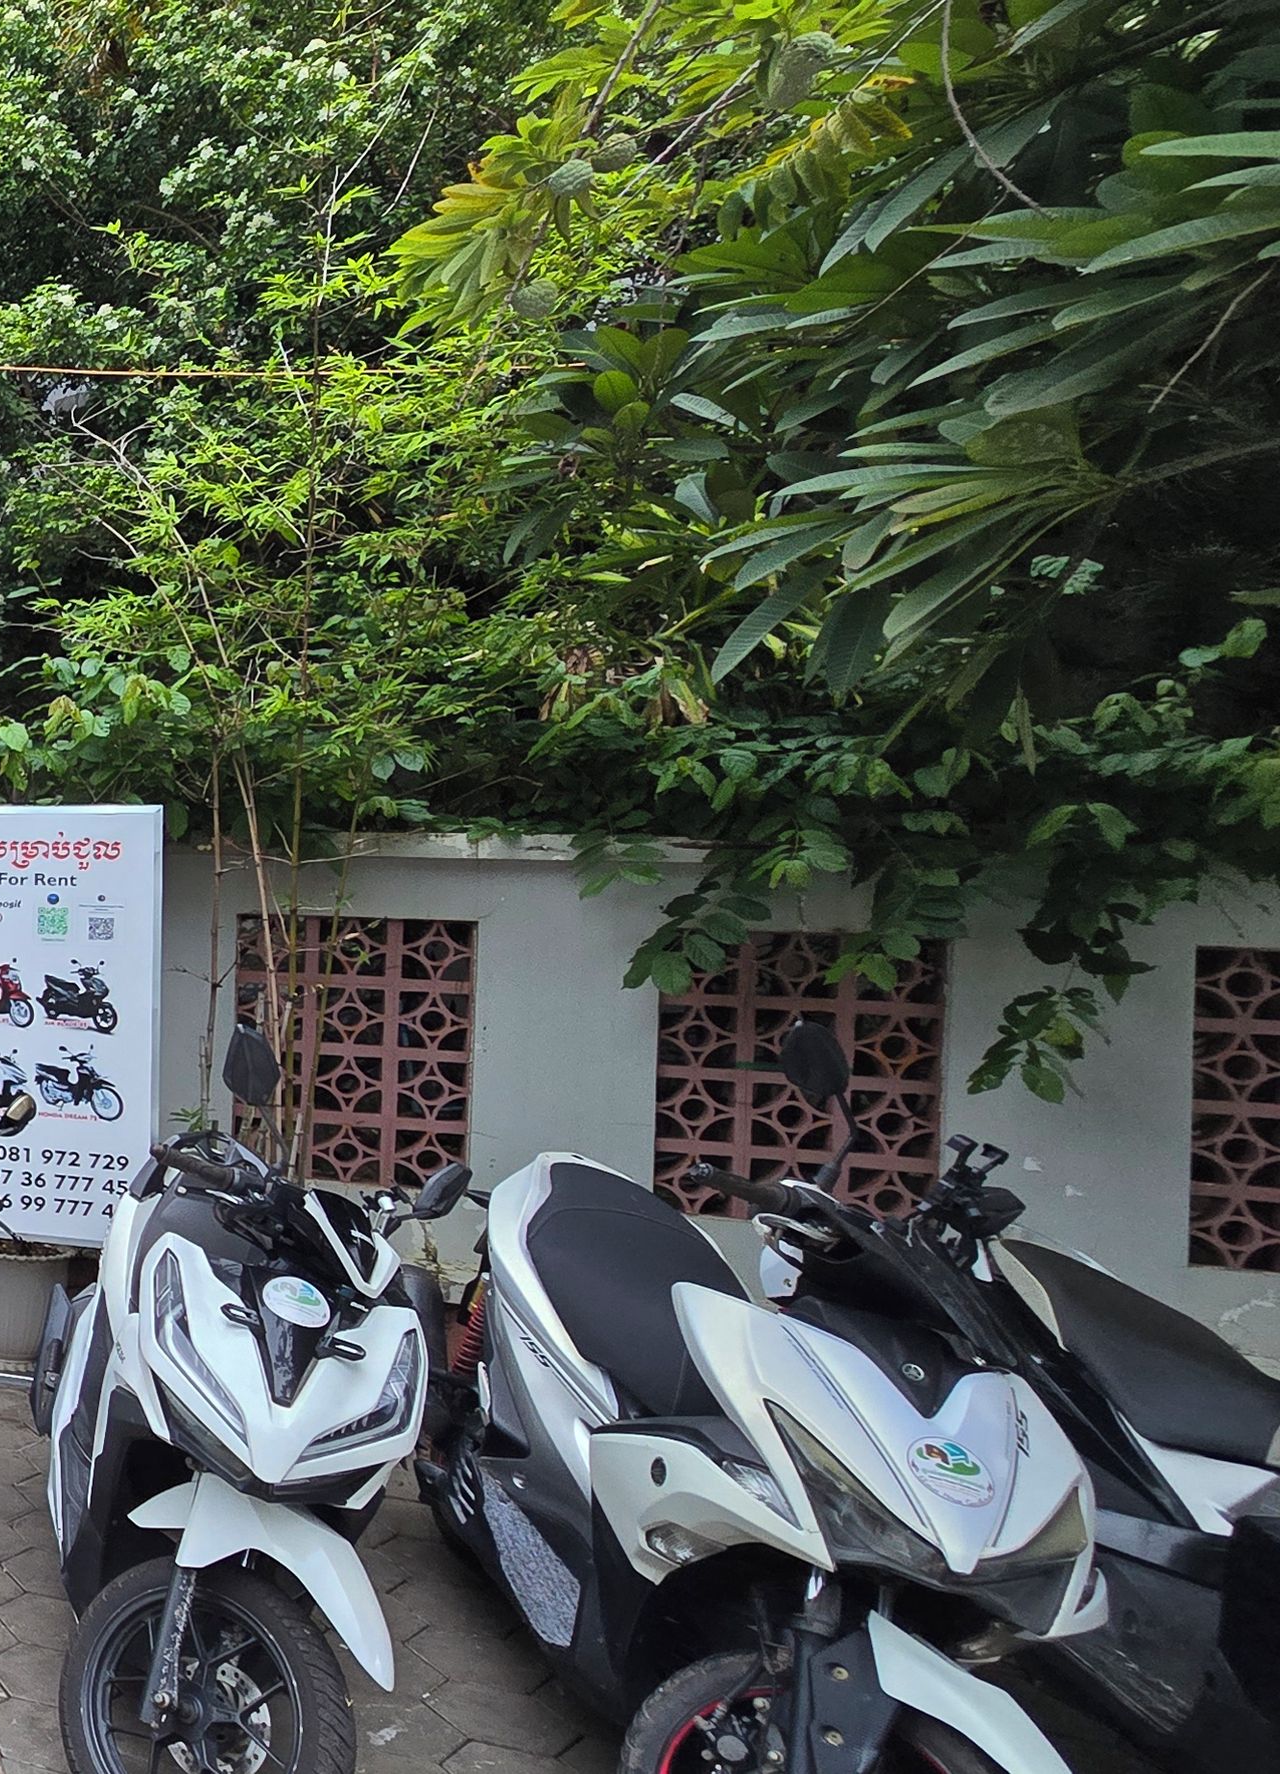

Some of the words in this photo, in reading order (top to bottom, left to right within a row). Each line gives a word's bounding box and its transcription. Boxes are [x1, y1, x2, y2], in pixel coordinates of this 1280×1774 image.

[34, 874, 77, 886] Rent
[41, 1149, 81, 1167] 972
[89, 1153, 129, 1171] 729
[20, 1171, 46, 1188] 36
[55, 1174, 94, 1192] 777
[101, 1179, 128, 1197] 45
[20, 1195, 46, 1211] 99
[54, 1198, 93, 1216] 777
[519, 1336, 551, 1368] 155
[1014, 1410, 1031, 1458] 155
